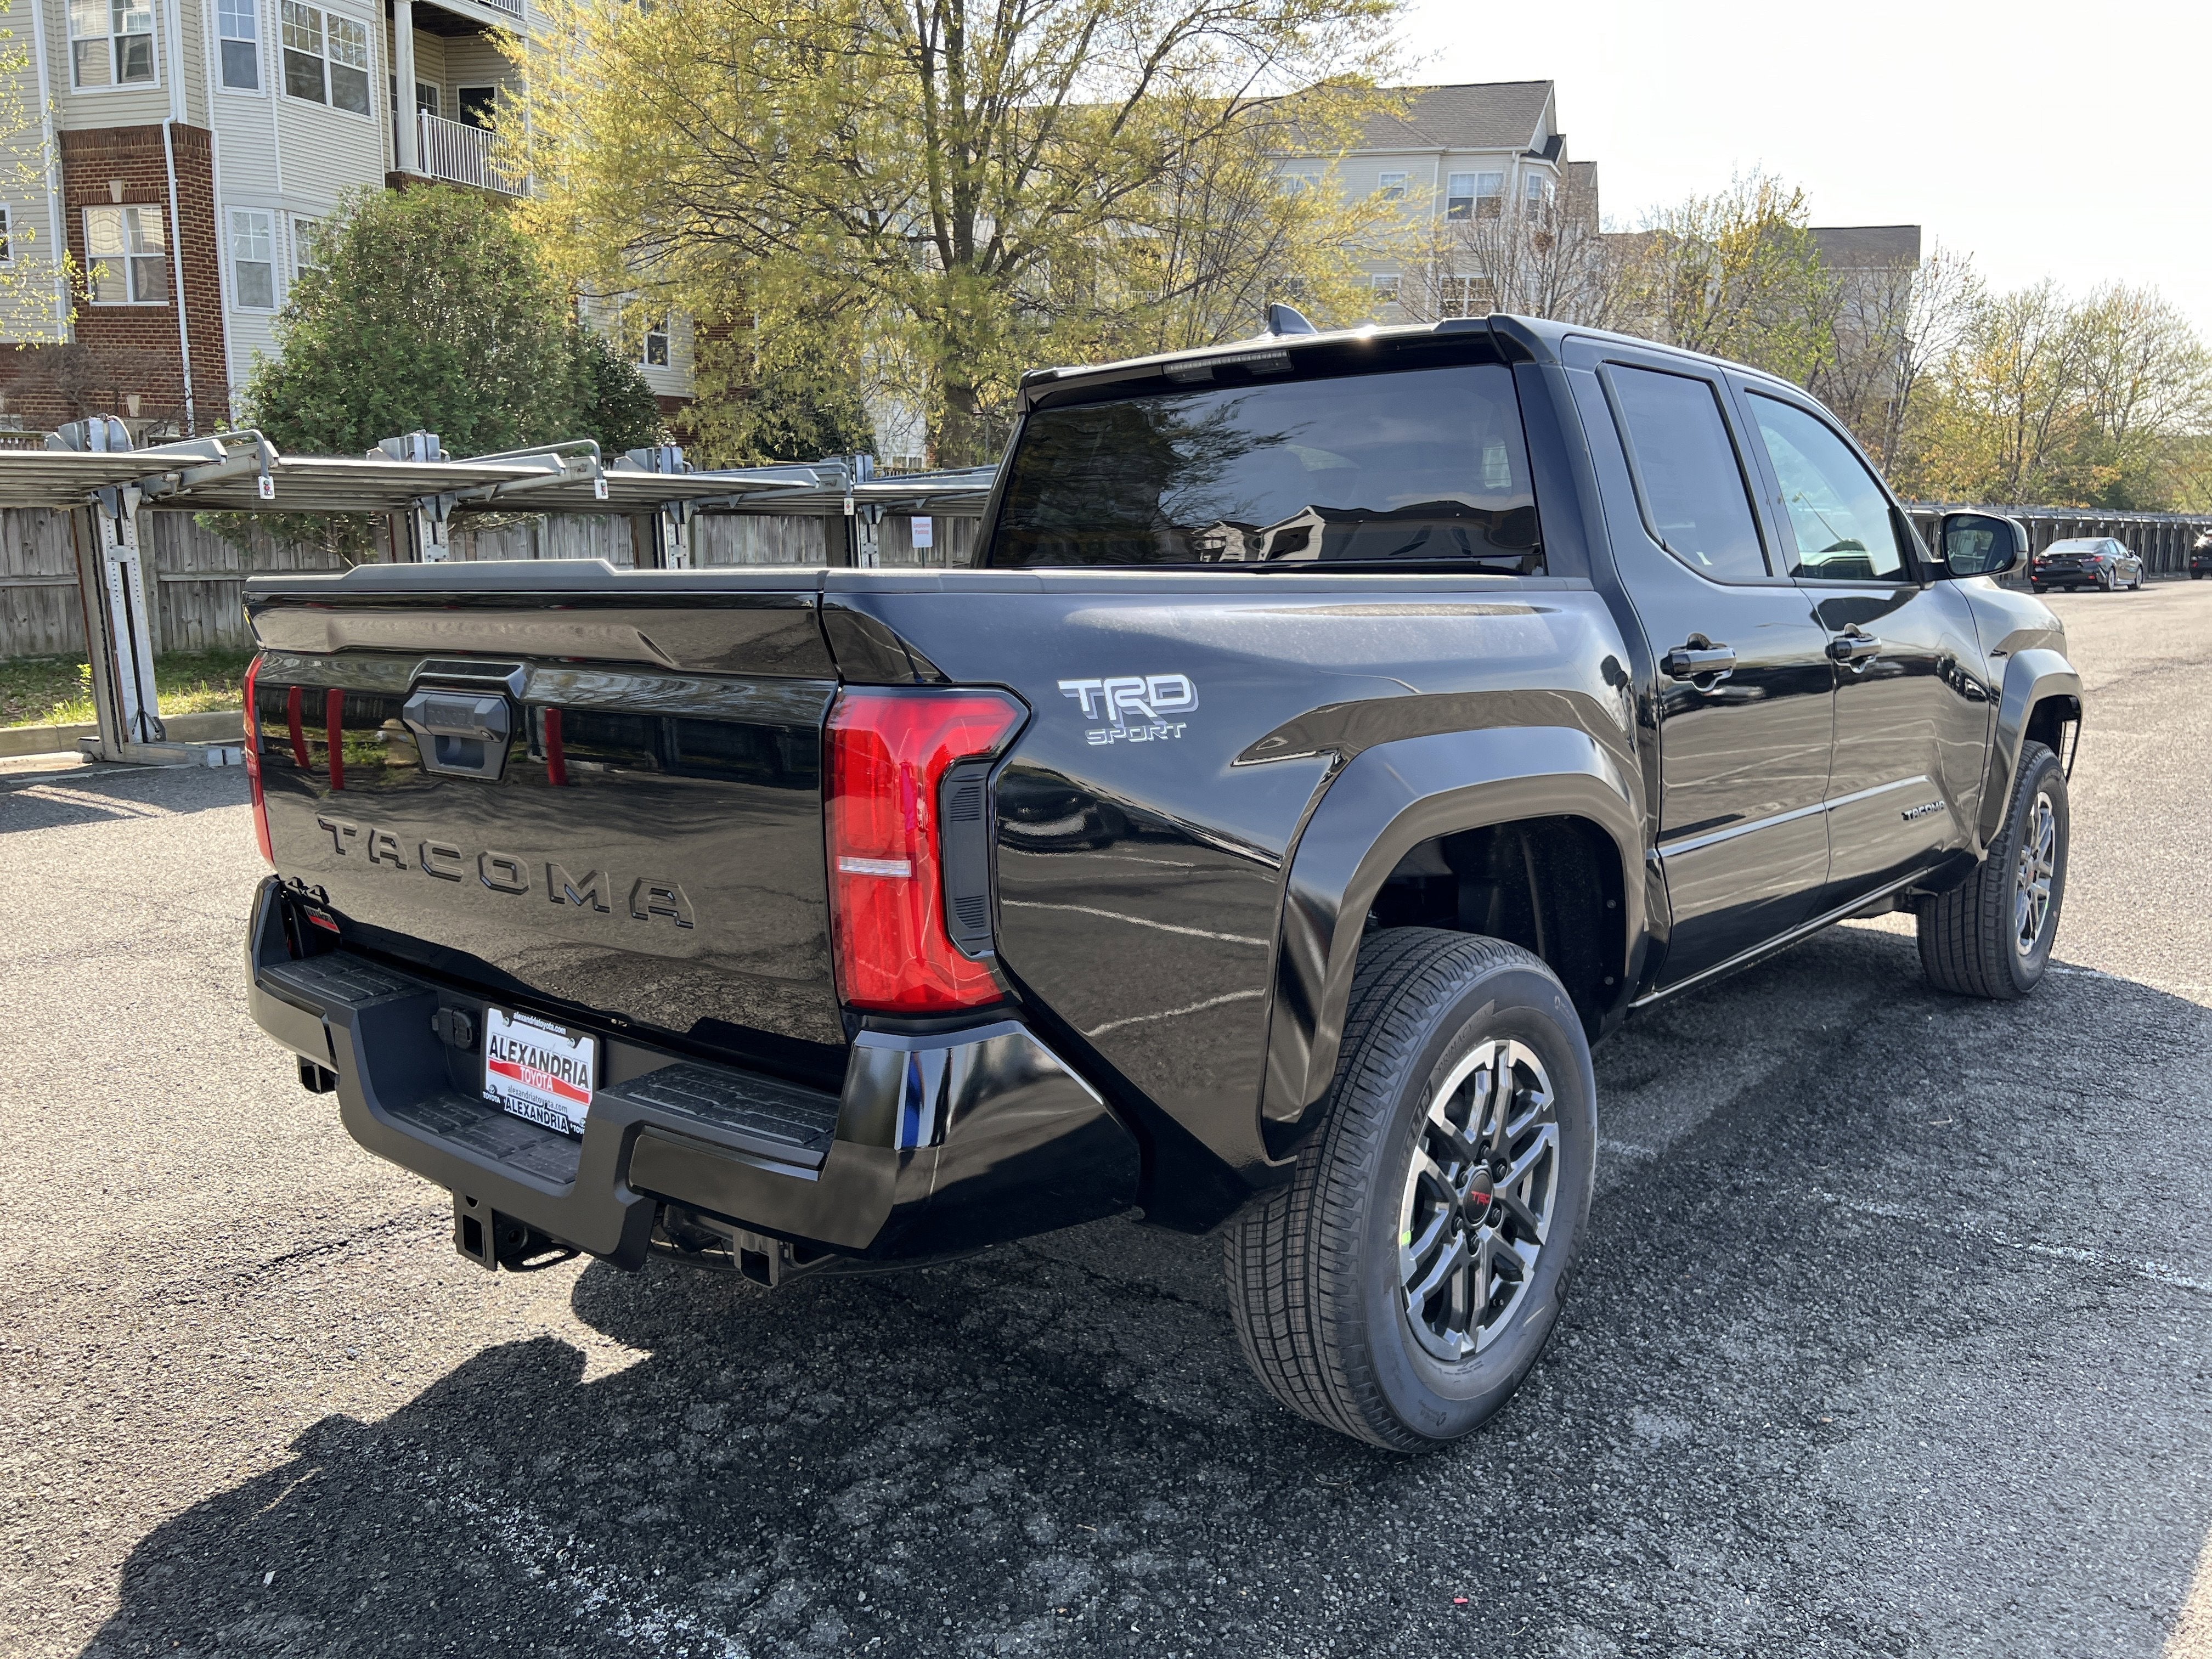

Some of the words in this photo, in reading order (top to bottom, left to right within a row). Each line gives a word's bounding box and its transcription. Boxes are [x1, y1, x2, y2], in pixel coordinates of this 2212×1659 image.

[1057, 673, 1199, 728] TRD
[1085, 722, 1187, 746] SPORT
[1901, 800, 1945, 821] TACOMA
[317, 813, 695, 929] TACOMA
[490, 1035, 589, 1088] ALEXANDRIA
[520, 1066, 554, 1092] TOYOTA
[483, 1091, 500, 1104] TOYOTA
[505, 1097, 569, 1134] ALEXANDRIA
